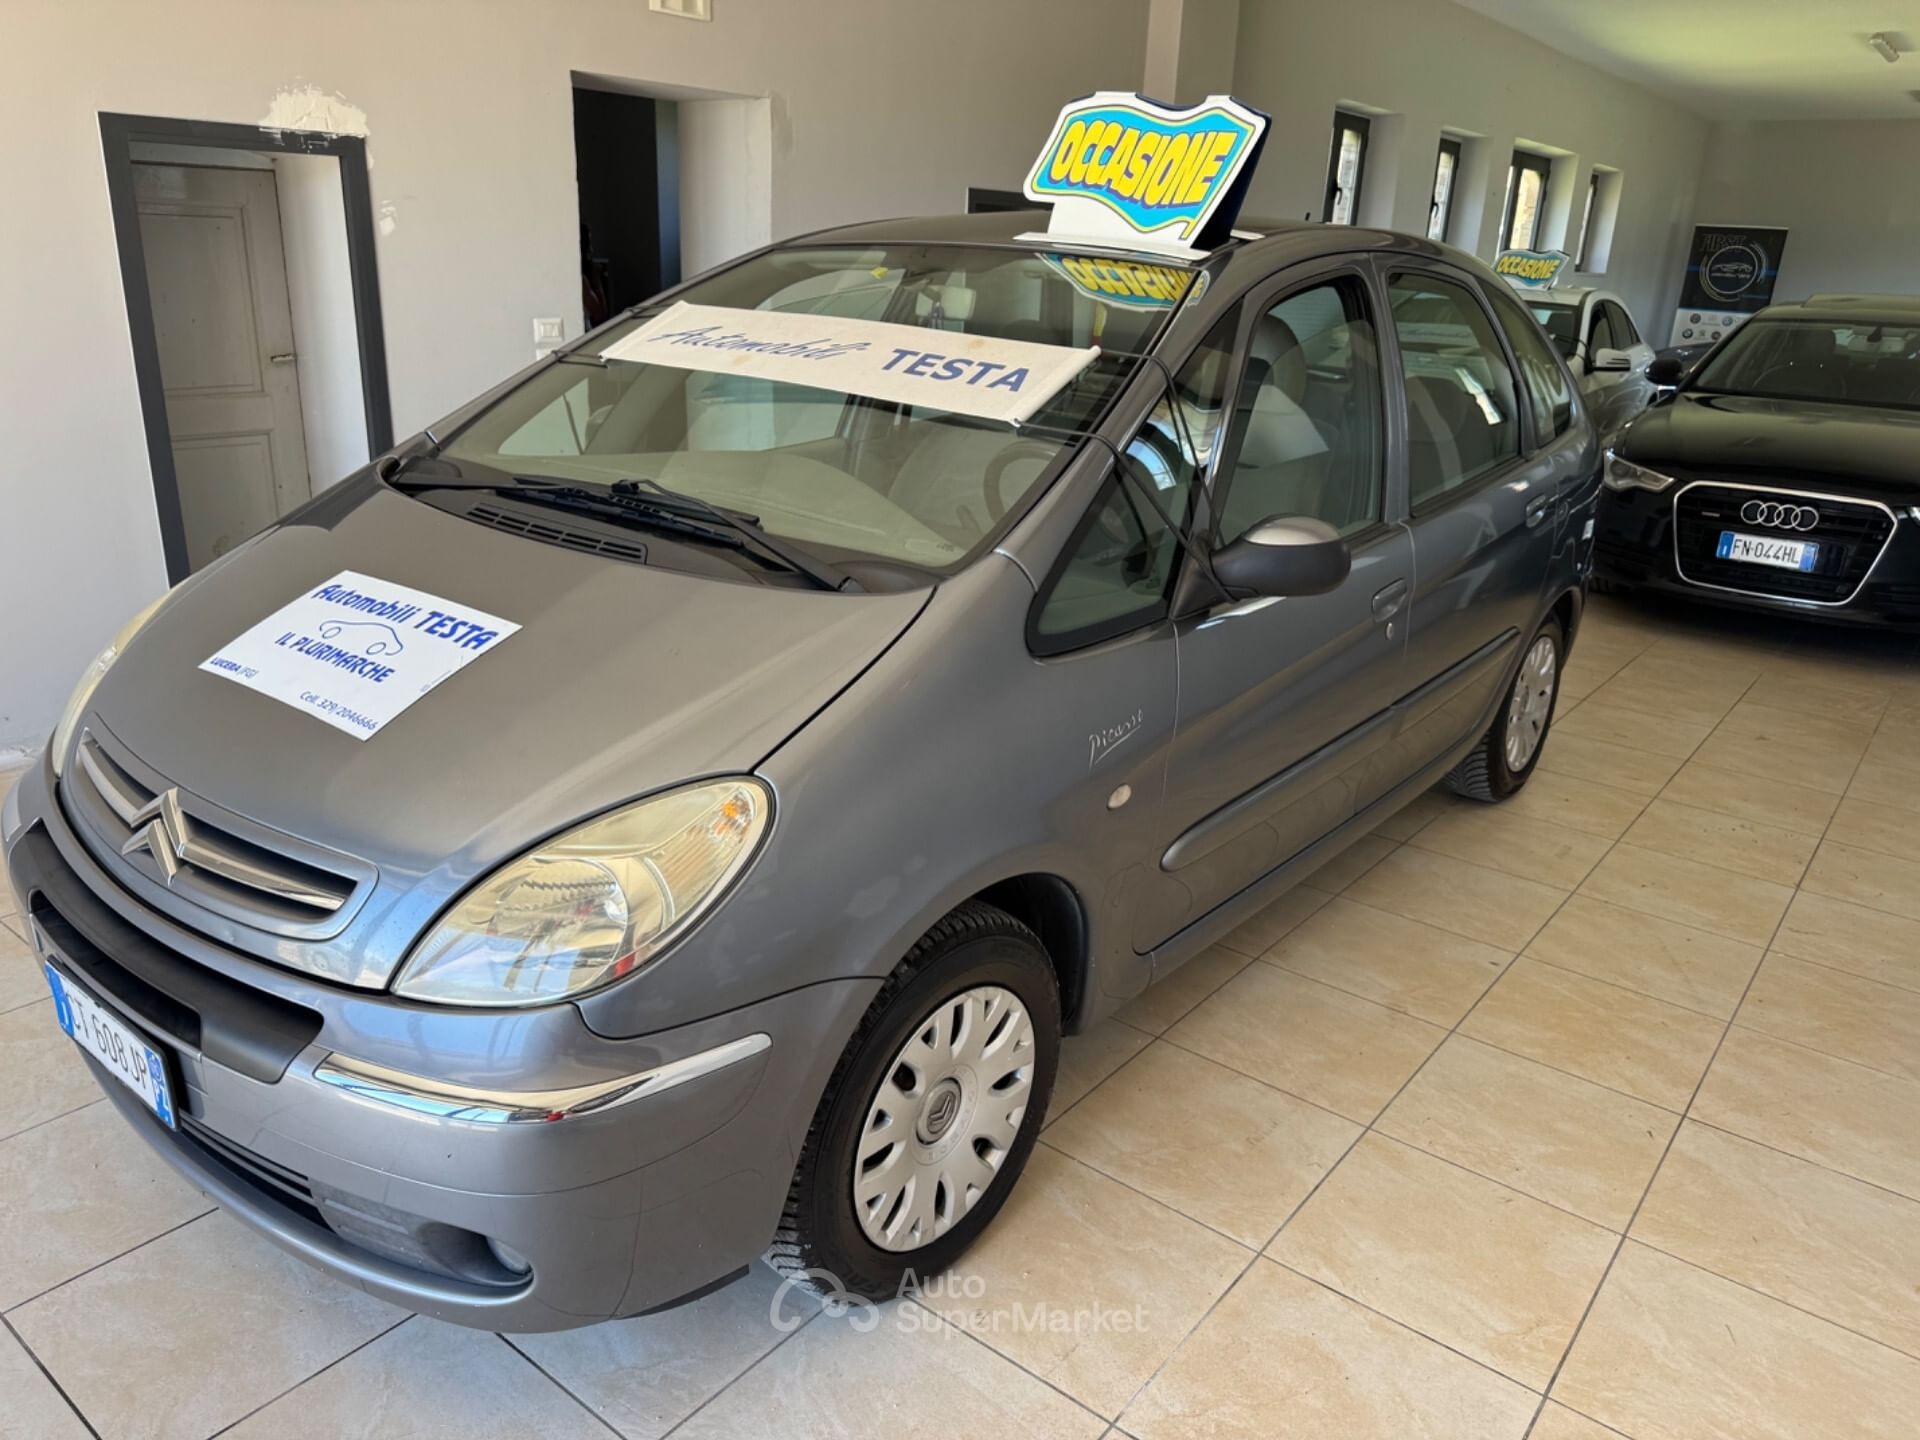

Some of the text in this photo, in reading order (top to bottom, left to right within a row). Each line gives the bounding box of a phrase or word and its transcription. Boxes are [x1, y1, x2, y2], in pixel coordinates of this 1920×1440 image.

[1049, 119, 1238, 208] OCCASIONE
[1496, 256, 1560, 279] OCCASIONE
[882, 348, 1029, 392] TESTA
[313, 584, 499, 650] Automobili TESTA
[210, 657, 242, 672] LUCERA
[275, 631, 295, 649] IL
[292, 637, 395, 683] PLURIMARCHE
